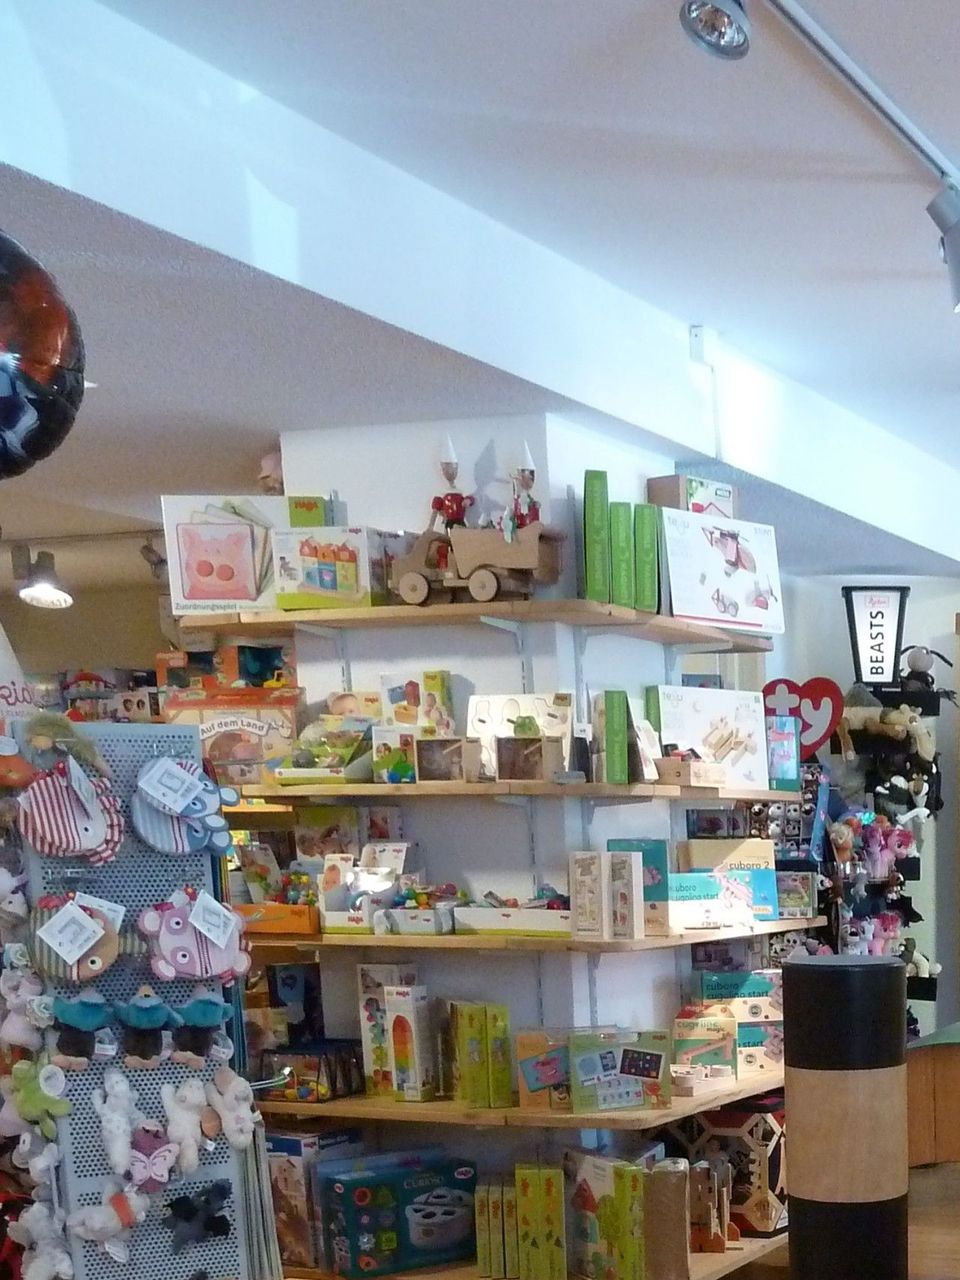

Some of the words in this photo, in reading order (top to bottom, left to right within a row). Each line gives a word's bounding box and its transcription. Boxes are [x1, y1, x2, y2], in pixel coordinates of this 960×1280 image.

[870, 611, 884, 675] BEASTS
[765, 683, 833, 746] ty
[201, 723, 216, 736] Auf
[217, 720, 238, 730] dem
[240, 720, 264, 732] Land
[729, 860, 760, 870] cuboro
[764, 861, 770, 869] 2
[703, 892, 719, 900] start
[706, 981, 739, 992] cuboro
[747, 990, 769, 998] start
